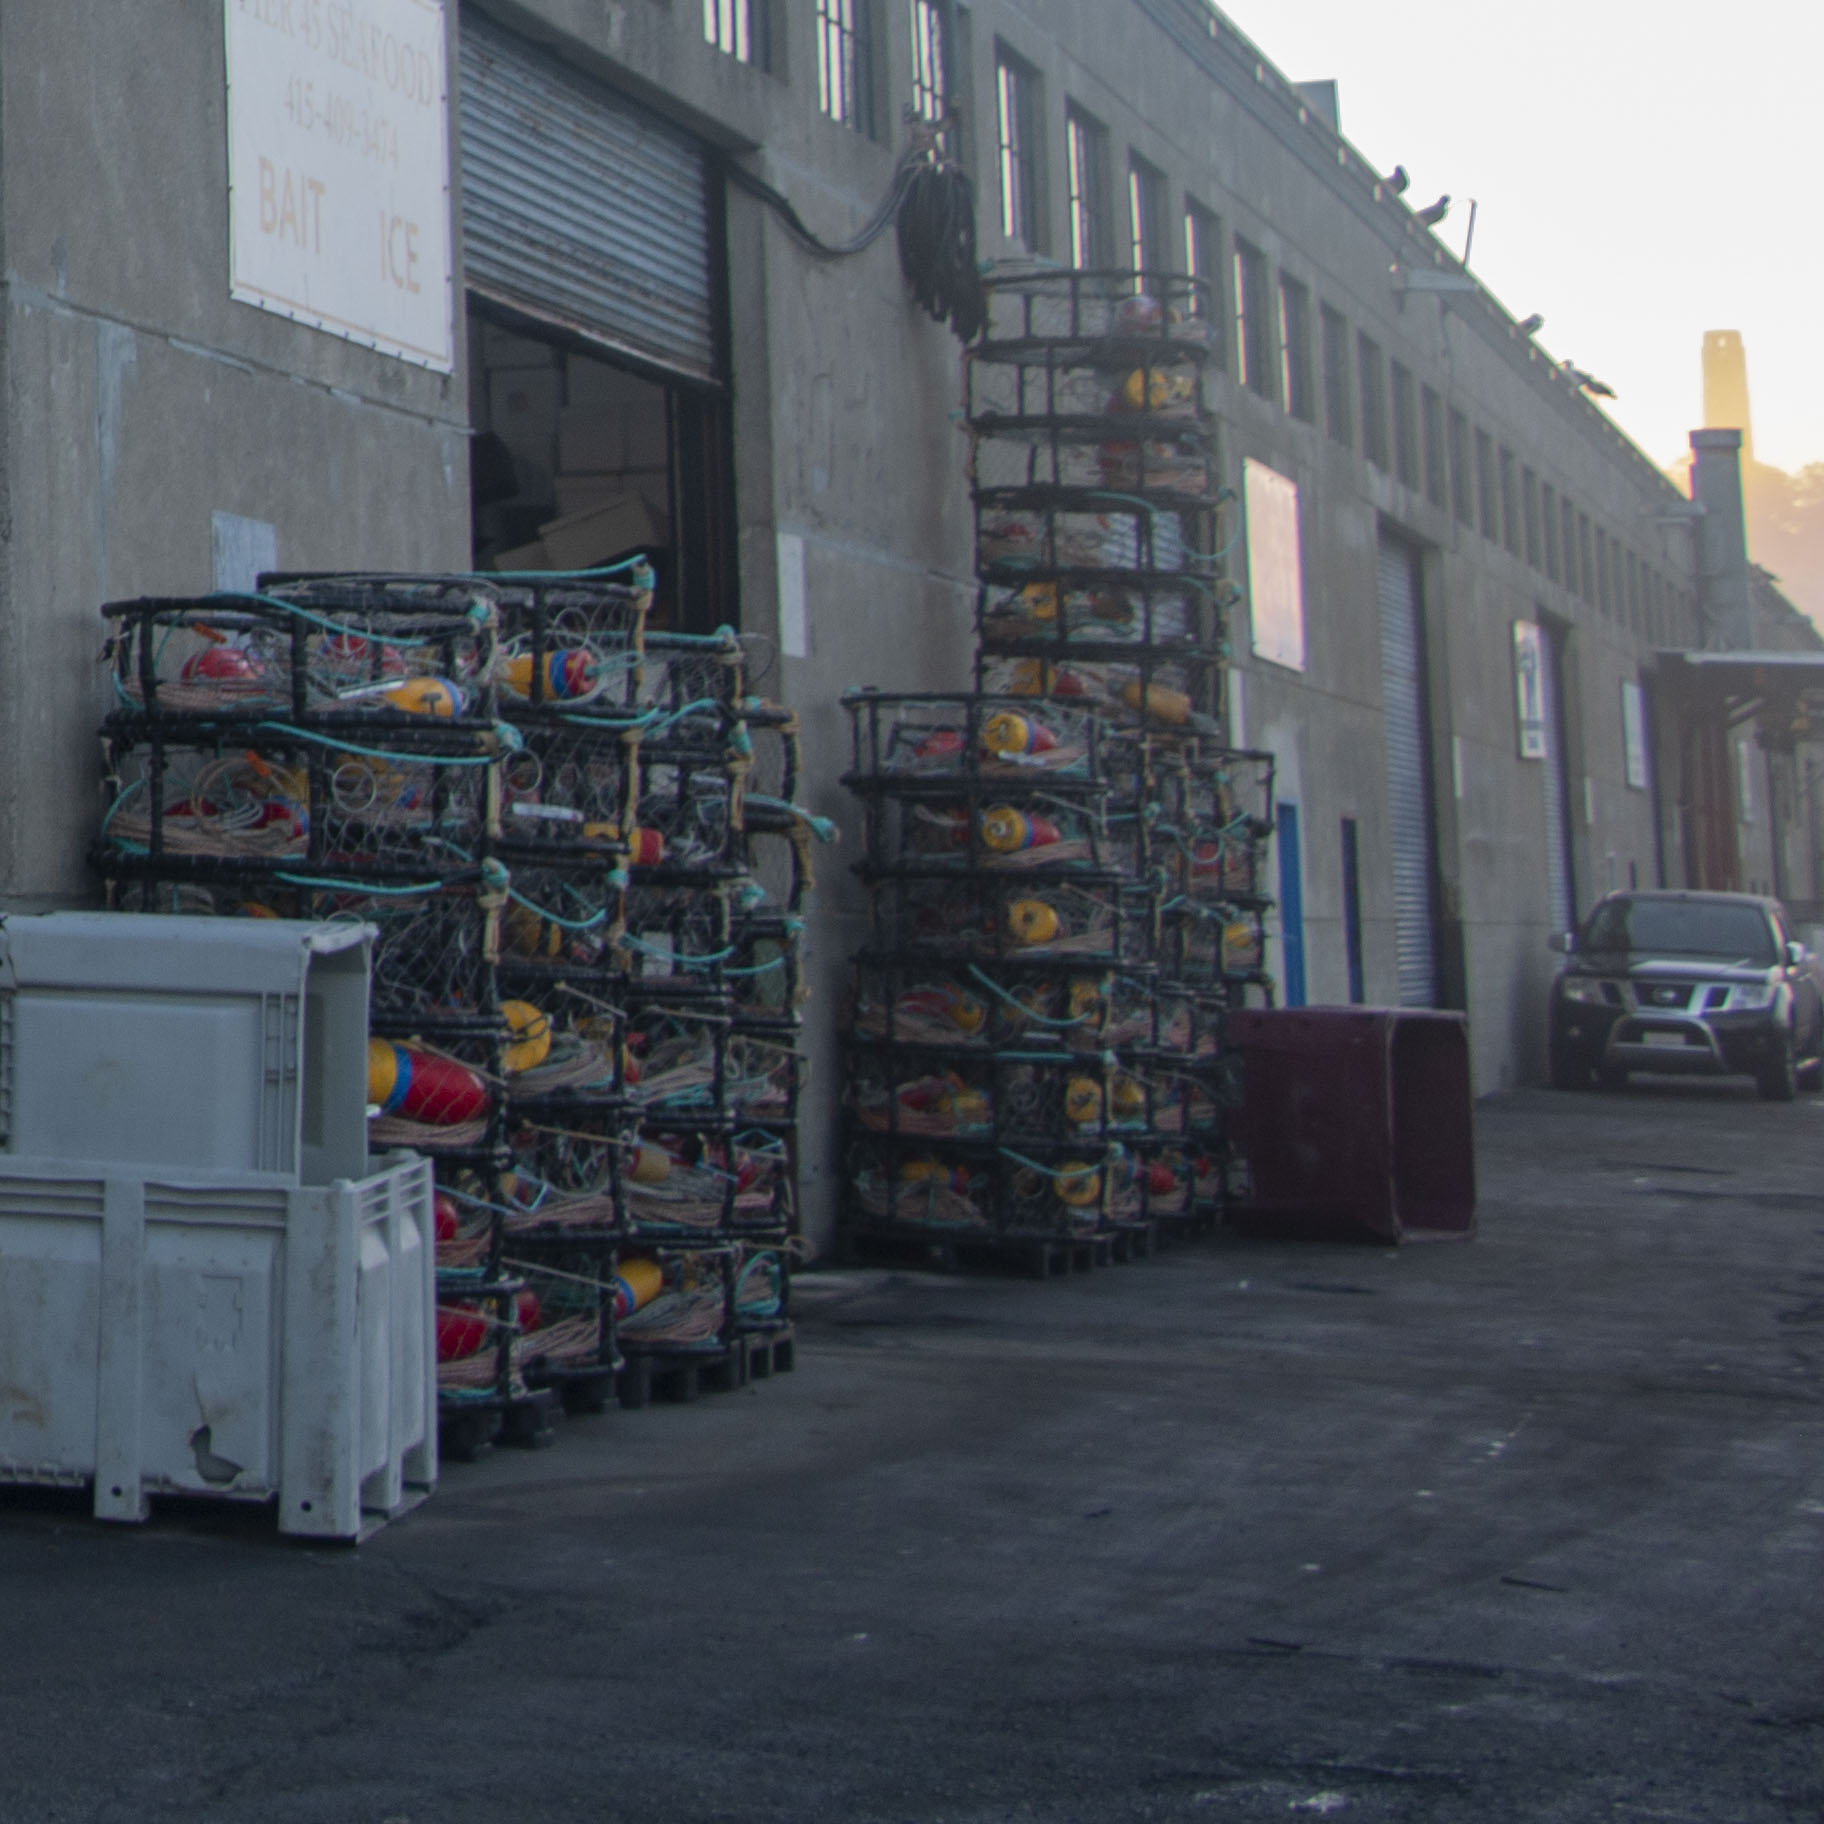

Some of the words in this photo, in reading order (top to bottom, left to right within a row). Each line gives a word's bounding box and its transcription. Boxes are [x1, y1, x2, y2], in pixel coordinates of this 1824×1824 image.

[327, 1, 435, 108] SEAFOOD
[258, 154, 326, 256] BAIT
[379, 209, 422, 296] ICE
